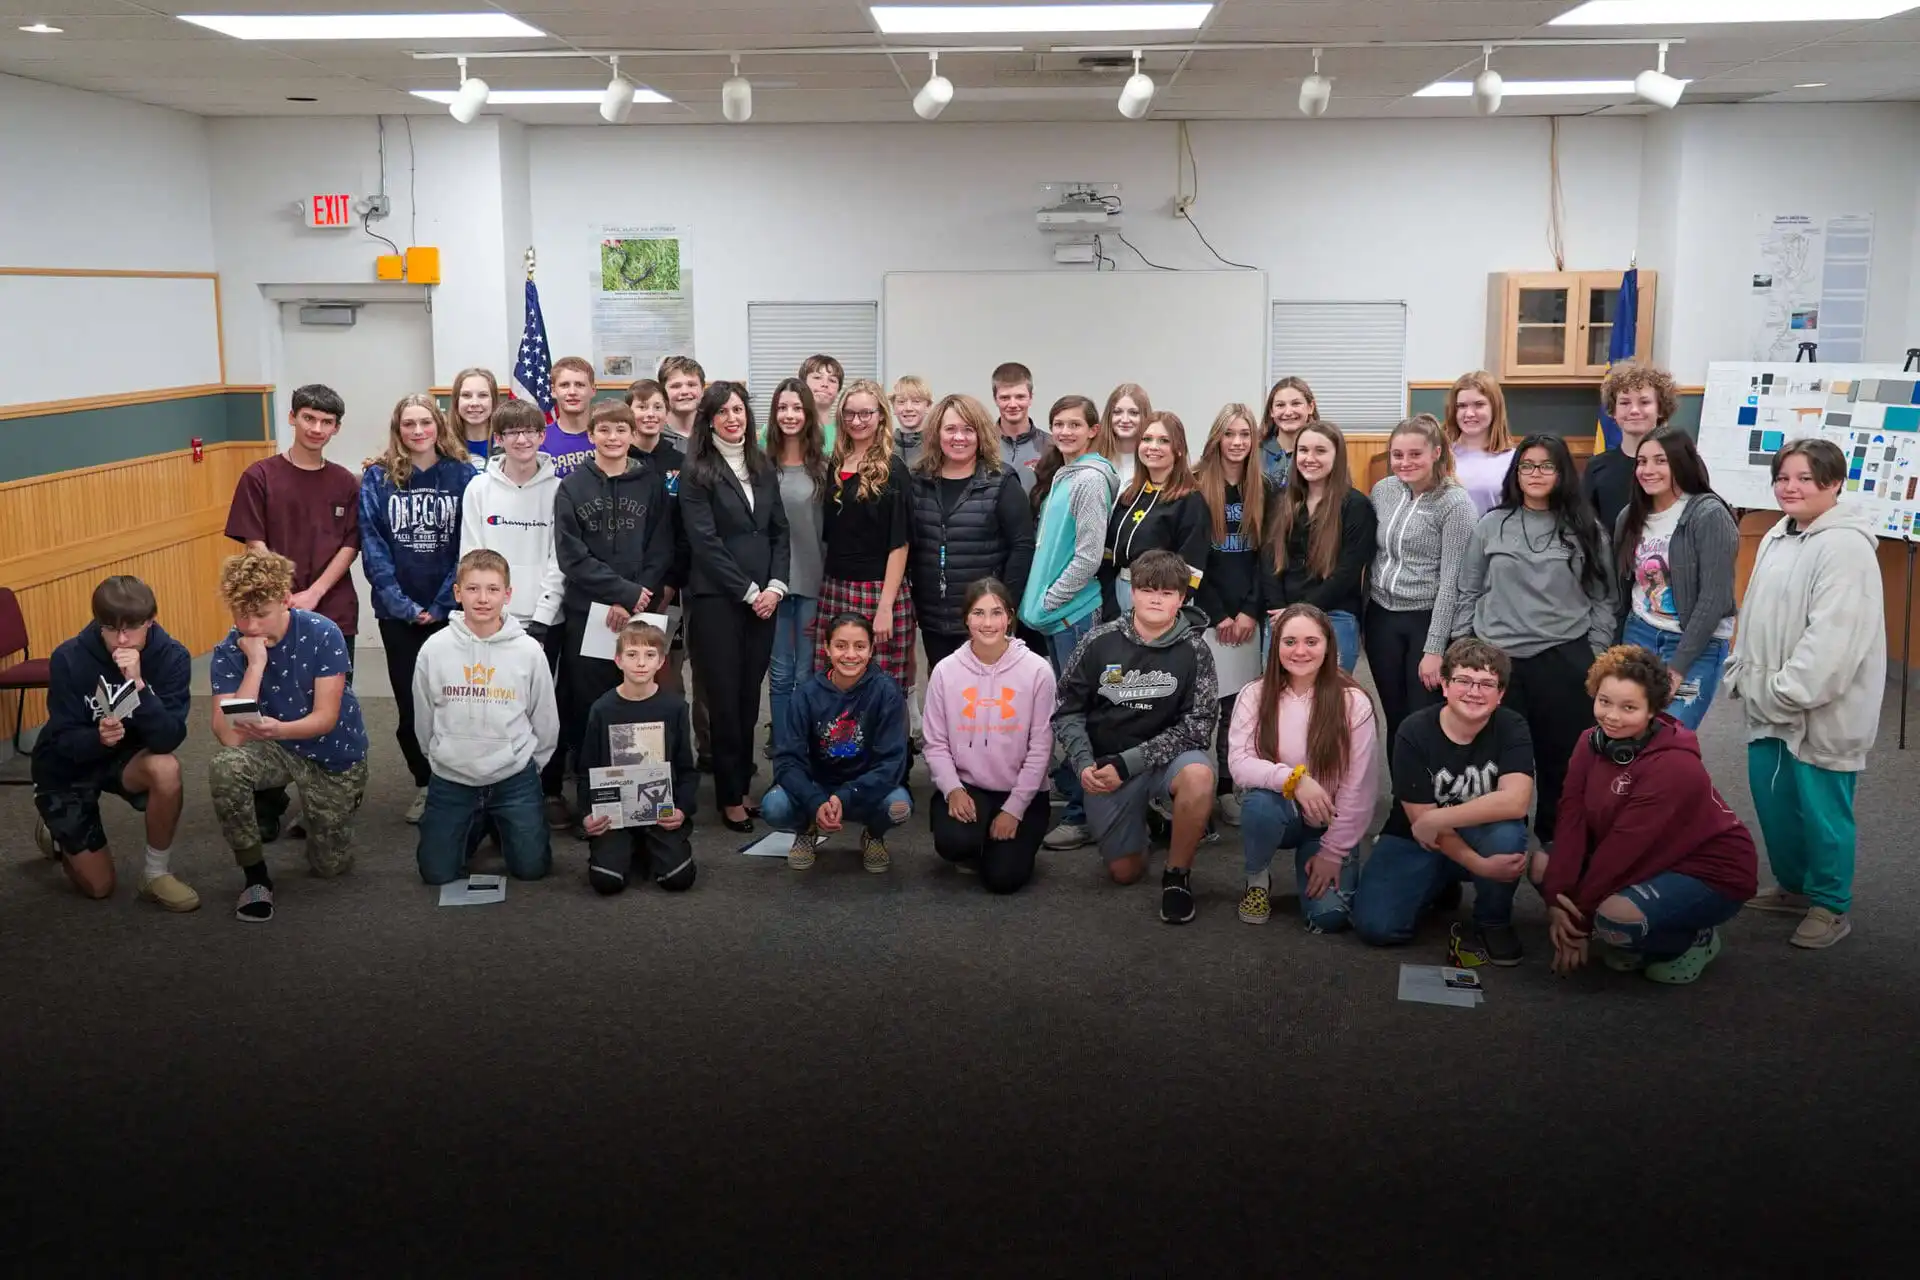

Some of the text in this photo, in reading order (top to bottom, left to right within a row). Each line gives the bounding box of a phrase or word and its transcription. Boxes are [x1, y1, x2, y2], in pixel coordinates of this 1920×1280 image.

[313, 194, 350, 225] EXIT
[388, 493, 459, 534] OREGON
[487, 515, 548, 531] Champion
[1119, 687, 1157, 698] VALLEY
